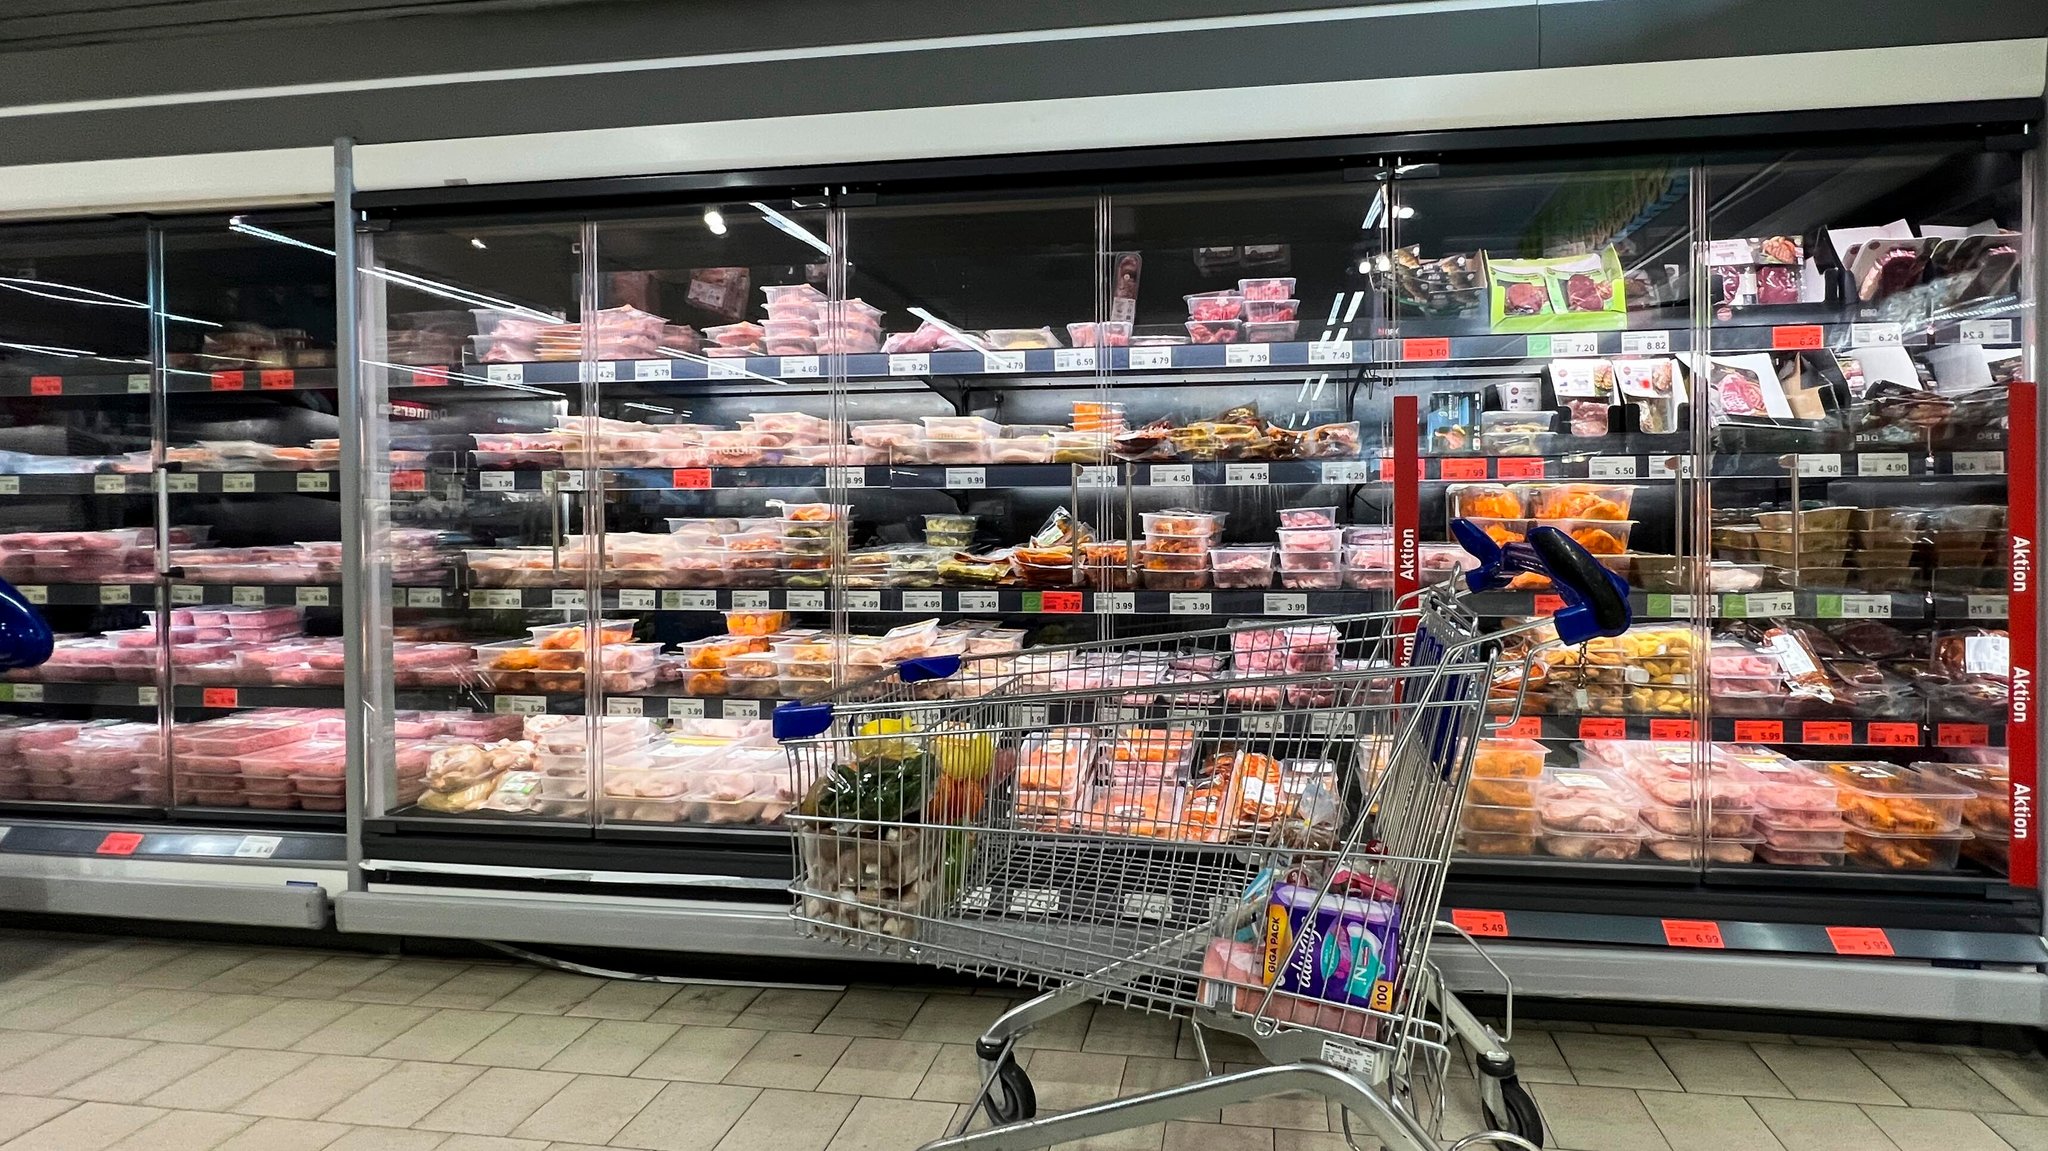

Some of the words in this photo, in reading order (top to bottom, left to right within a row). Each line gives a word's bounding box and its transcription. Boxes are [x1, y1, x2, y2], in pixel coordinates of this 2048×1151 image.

[1799, 336, 1819, 346] 6.29
[1878, 333, 1899, 341] 6.24
[1575, 344, 1595, 353] 7.20
[1646, 341, 1666, 350] 8.82
[1249, 354, 1267, 362] 7.39
[1332, 350, 1350, 359] 7.49
[1076, 358, 1094, 366] 6.59
[1152, 356, 1169, 364] 4.79
[912, 363, 928, 371] 9.29
[1006, 361, 1023, 369] 4.79
[507, 374, 521, 382] 5.29
[599, 371, 614, 379] 4.29
[654, 370, 670, 378] 5.79
[1614, 467, 1634, 475] 5.50
[1817, 464, 1839, 473] 4.90
[1885, 463, 1907, 472] 4.90
[1249, 471, 1269, 480] 4.95
[1345, 470, 1364, 479] 4.29
[1465, 469, 1484, 477] 7.99
[846, 477, 862, 485] 8.99
[967, 476, 984, 484] 9.99
[1172, 474, 1191, 482] 4.50
[499, 480, 513, 488] 1.99
[1399, 528, 1414, 581] Aktion
[2012, 536, 2031, 592] Aktion
[699, 599, 715, 607] 4.99
[752, 599, 768, 608] 3.99
[806, 599, 823, 607] 4.79
[861, 600, 878, 608] 4.99
[923, 600, 941, 608] 4.99
[979, 601, 997, 609] 3.49
[1115, 602, 1133, 610] 3.99
[1192, 602, 1210, 611] 3.99
[1287, 603, 1306, 612] 3.99
[1772, 602, 1792, 611] 7.62
[1868, 604, 1889, 613] 8.75
[2012, 666, 2031, 723] Aktion
[686, 706, 703, 715] 3.99
[742, 708, 758, 717] 3.99
[1264, 722, 1283, 730] 5.9
[1519, 728, 1539, 736] 5.49
[1603, 729, 1623, 737] 4.29
[1760, 732, 1780, 741] 5.99
[1894, 734, 1915, 743] 3.79
[2013, 782, 2032, 839] Aktion
[1270, 917, 1280, 946] PACK
[1482, 922, 1504, 932] 5.49
[1696, 933, 1719, 943] 6.99
[1863, 939, 1888, 950] 5.99
[1268, 947, 1278, 973] GIGA
[1377, 984, 1388, 1006] 100
